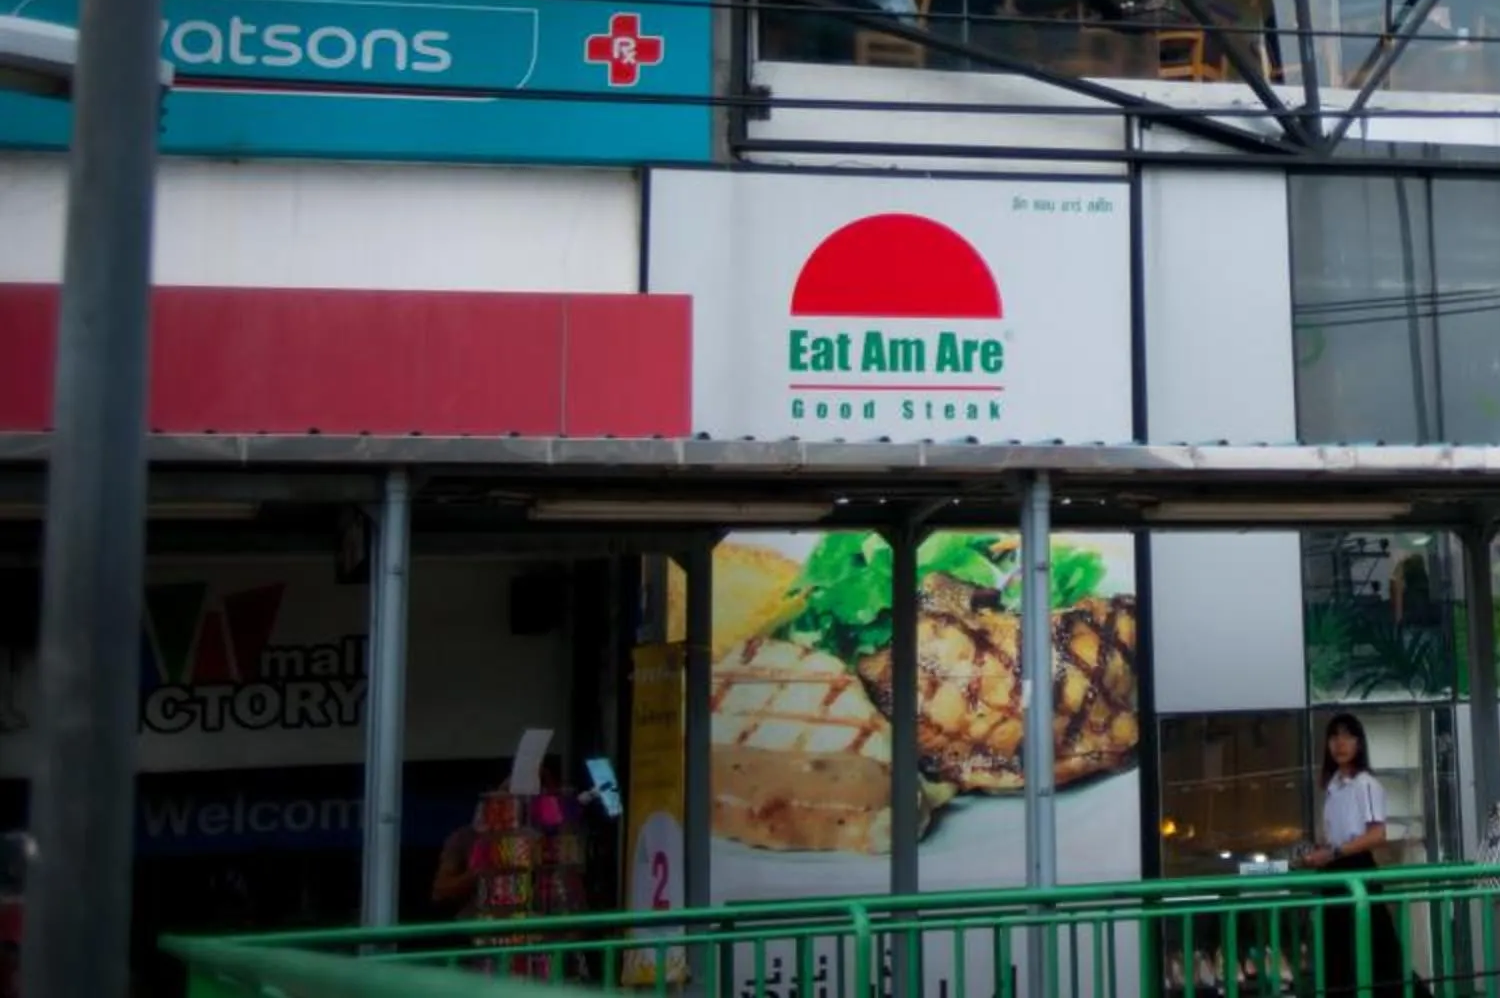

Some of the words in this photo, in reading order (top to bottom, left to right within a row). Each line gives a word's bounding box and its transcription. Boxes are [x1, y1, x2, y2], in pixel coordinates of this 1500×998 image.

[159, 14, 453, 73] atsons
[789, 329, 852, 372] Eat
[860, 330, 926, 373] Am
[935, 331, 1004, 374] Are
[791, 398, 876, 420] Good
[902, 399, 1002, 421] Steak
[142, 677, 367, 734] CTORY
[142, 788, 364, 838] Welcom
